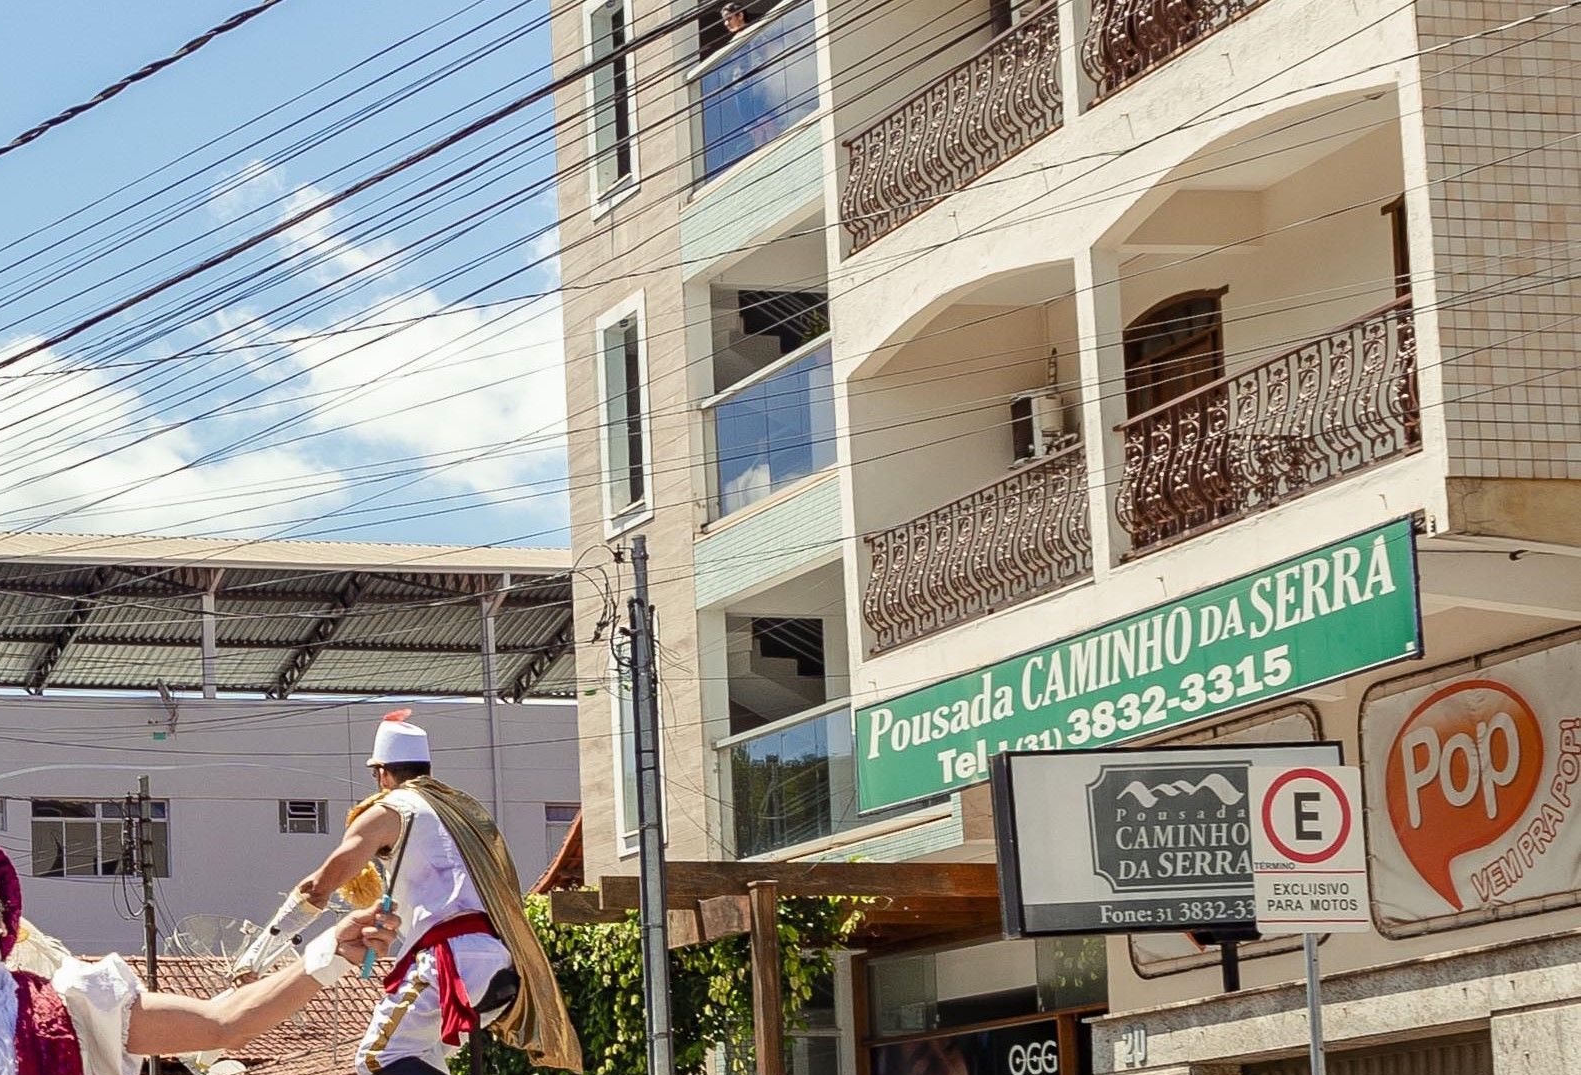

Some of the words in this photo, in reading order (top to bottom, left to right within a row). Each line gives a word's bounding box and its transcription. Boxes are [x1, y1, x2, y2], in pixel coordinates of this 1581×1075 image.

[867, 671, 1014, 760] Pousada
[1021, 606, 1193, 711] CAMINHO
[1198, 596, 1246, 648] DA
[1249, 534, 1397, 640] SERRA
[1066, 644, 1292, 746] 3832-3315
[1116, 805, 1247, 822] Pousada
[1293, 791, 1323, 841] E
[1115, 822, 1250, 850] CAMINHO
[1119, 860, 1152, 880] DA
[1156, 850, 1253, 879] SERRA
[1471, 849, 1524, 902] VEM
[1518, 803, 1565, 868] PRA
[1273, 883, 1349, 896] EXCLUSIVO
[1099, 904, 1153, 924] Fone:
[1155, 907, 1173, 923] 31
[1267, 900, 1304, 912] PARA
[1310, 899, 1358, 911] MOTOS
